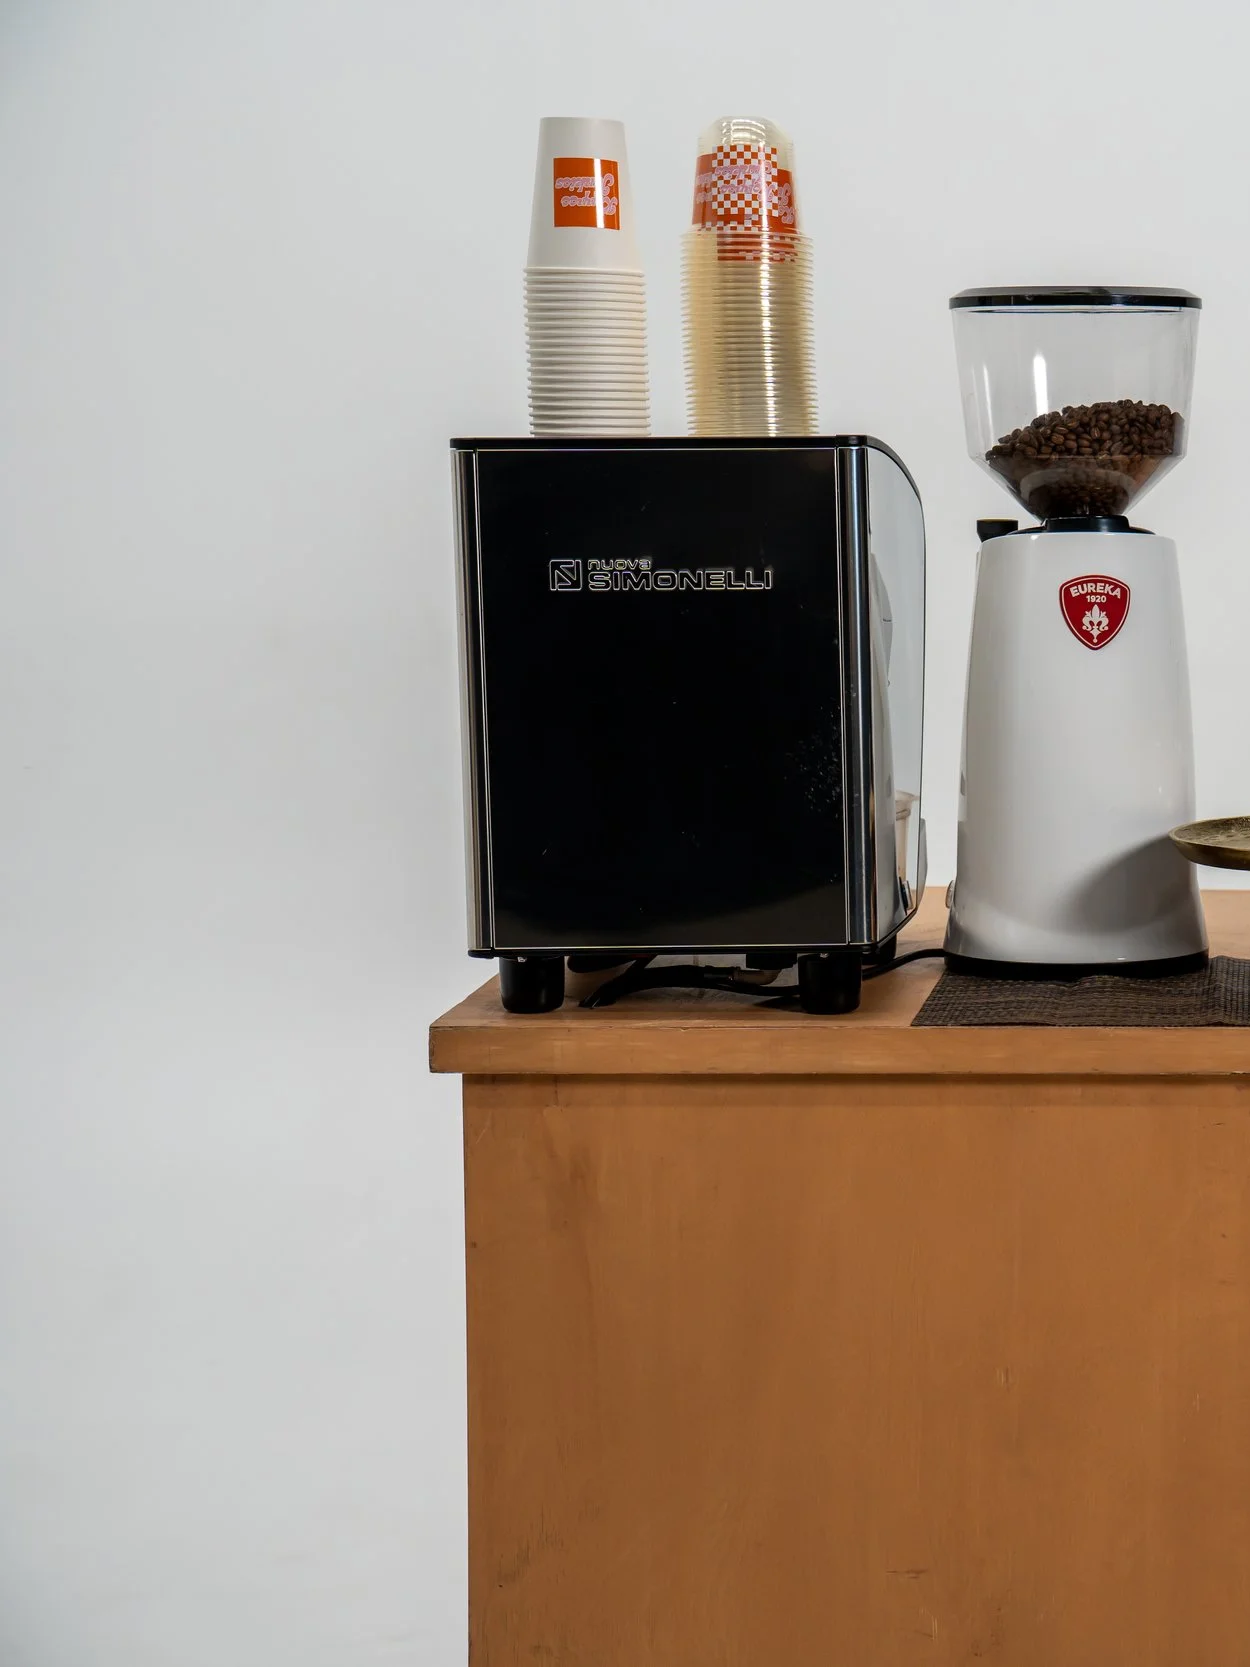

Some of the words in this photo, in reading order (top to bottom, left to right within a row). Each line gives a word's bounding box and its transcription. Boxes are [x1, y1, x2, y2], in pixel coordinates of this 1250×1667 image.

[587, 559, 651, 570] nuova
[588, 570, 773, 591] SIMONELLI
[1069, 582, 1121, 599] EUREKA
[1085, 595, 1107, 603] 1920
